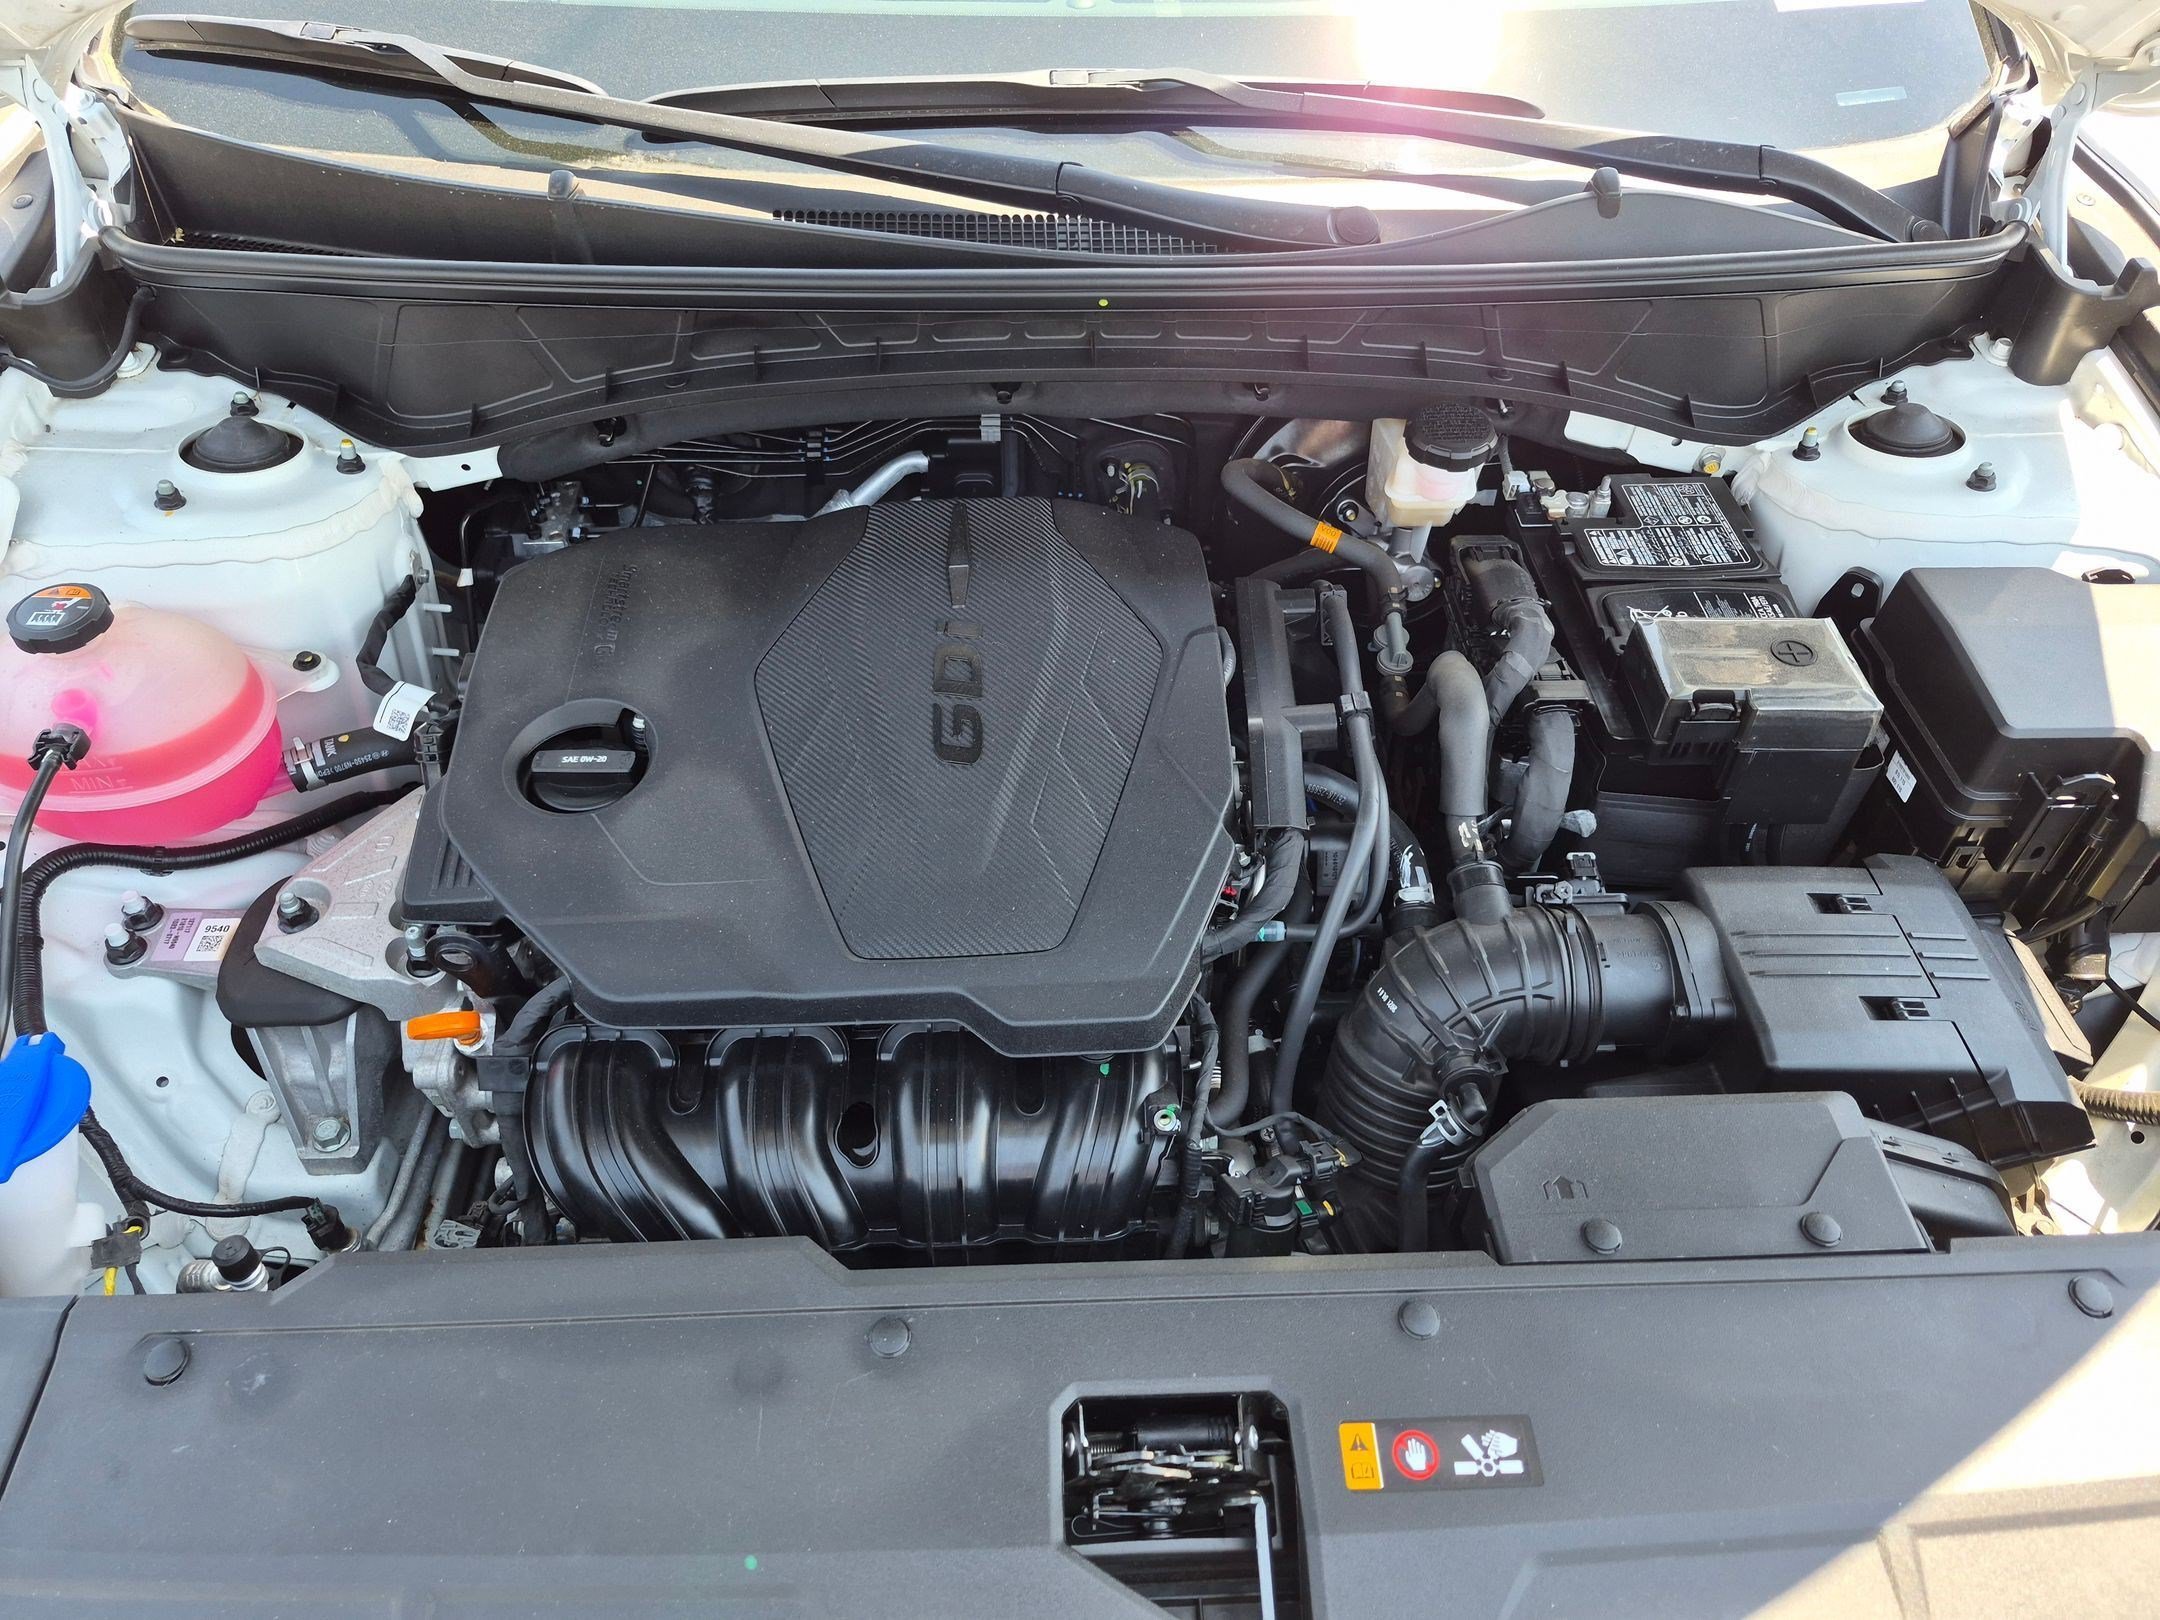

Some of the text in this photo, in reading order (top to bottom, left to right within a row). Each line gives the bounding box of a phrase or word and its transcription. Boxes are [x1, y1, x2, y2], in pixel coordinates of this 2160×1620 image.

[322, 737, 337, 758] TANK
[561, 755, 608, 763] SAE 0W-20
[204, 925, 231, 933] 9540
